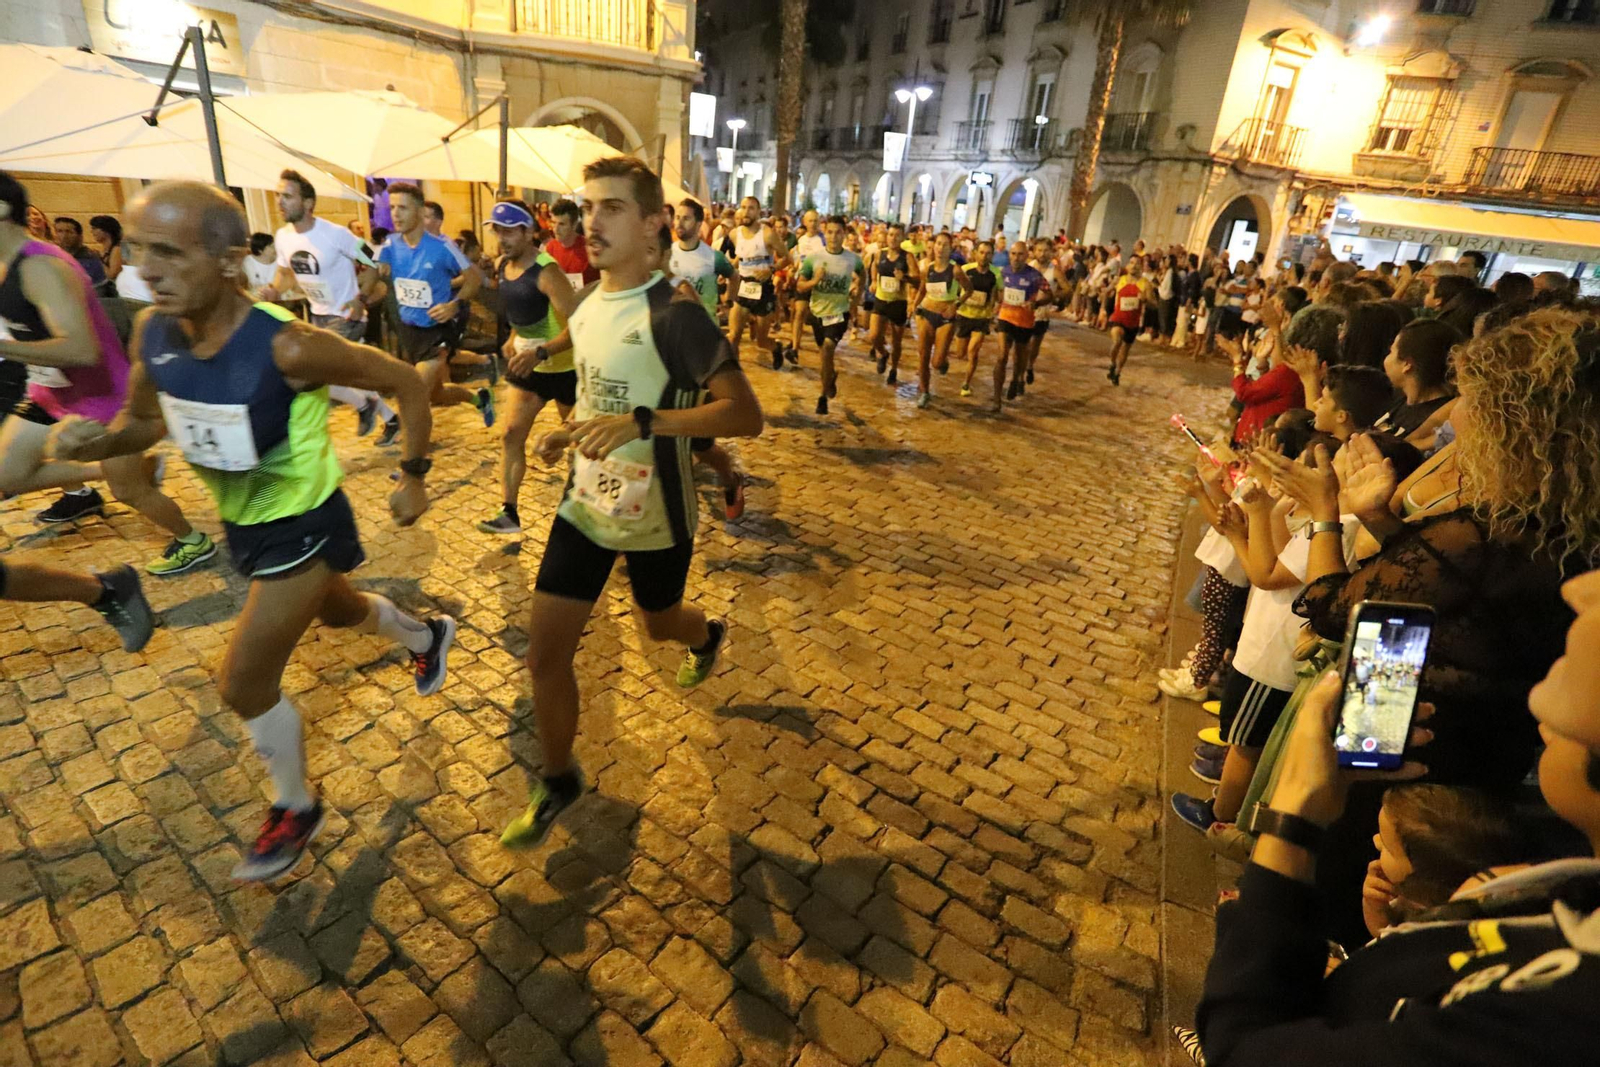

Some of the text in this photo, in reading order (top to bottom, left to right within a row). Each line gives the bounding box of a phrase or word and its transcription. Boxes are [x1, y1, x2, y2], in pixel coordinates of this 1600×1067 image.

[1370, 225, 1546, 257] RESTAURANTE
[402, 287, 423, 300] 352
[598, 473, 623, 500] 88
